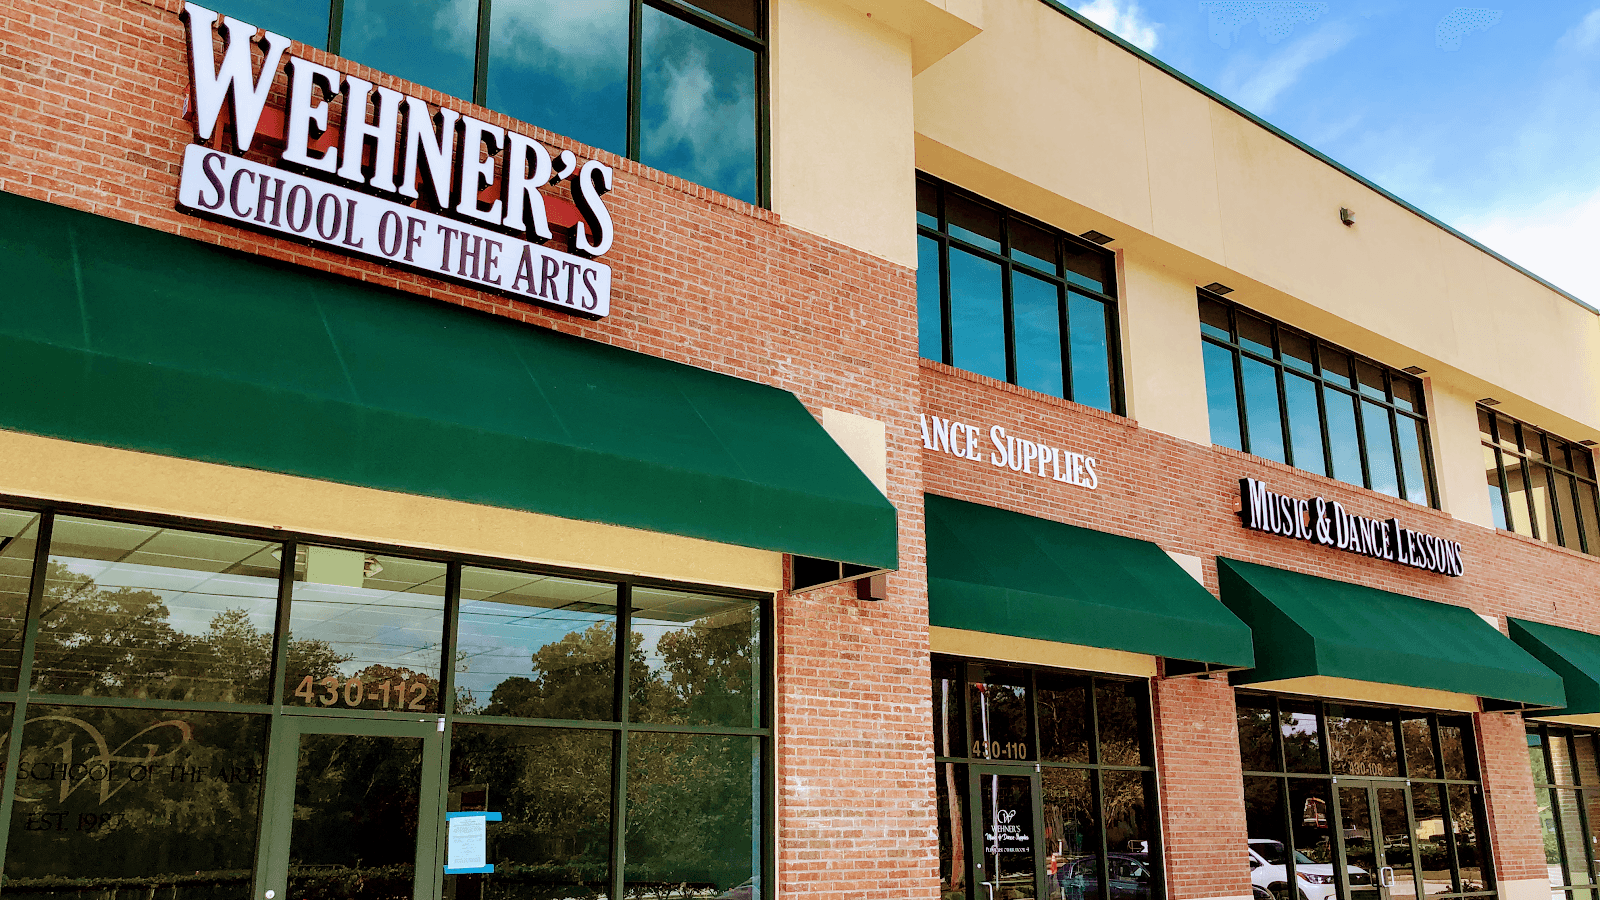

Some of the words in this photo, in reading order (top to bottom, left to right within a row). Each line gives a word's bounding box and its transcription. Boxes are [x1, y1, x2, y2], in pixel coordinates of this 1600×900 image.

[185, 2, 614, 256] WEHNER'S
[199, 153, 364, 249] SCHOOL
[378, 210, 427, 262] OF
[438, 226, 505, 285] THE
[512, 245, 598, 311] ARTS
[990, 425, 1098, 490] SUPPLIES
[1247, 477, 1312, 541] MUSIC
[1316, 497, 1335, 545] &
[1334, 501, 1394, 560] DANCE
[1393, 518, 1464, 577] LESSONS
[295, 675, 427, 711] 430-112
[16, 762, 119, 782] SCHOOL
[128, 765, 161, 782] OF
[165, 765, 209, 784] THE
[972, 740, 1027, 760] 430-110
